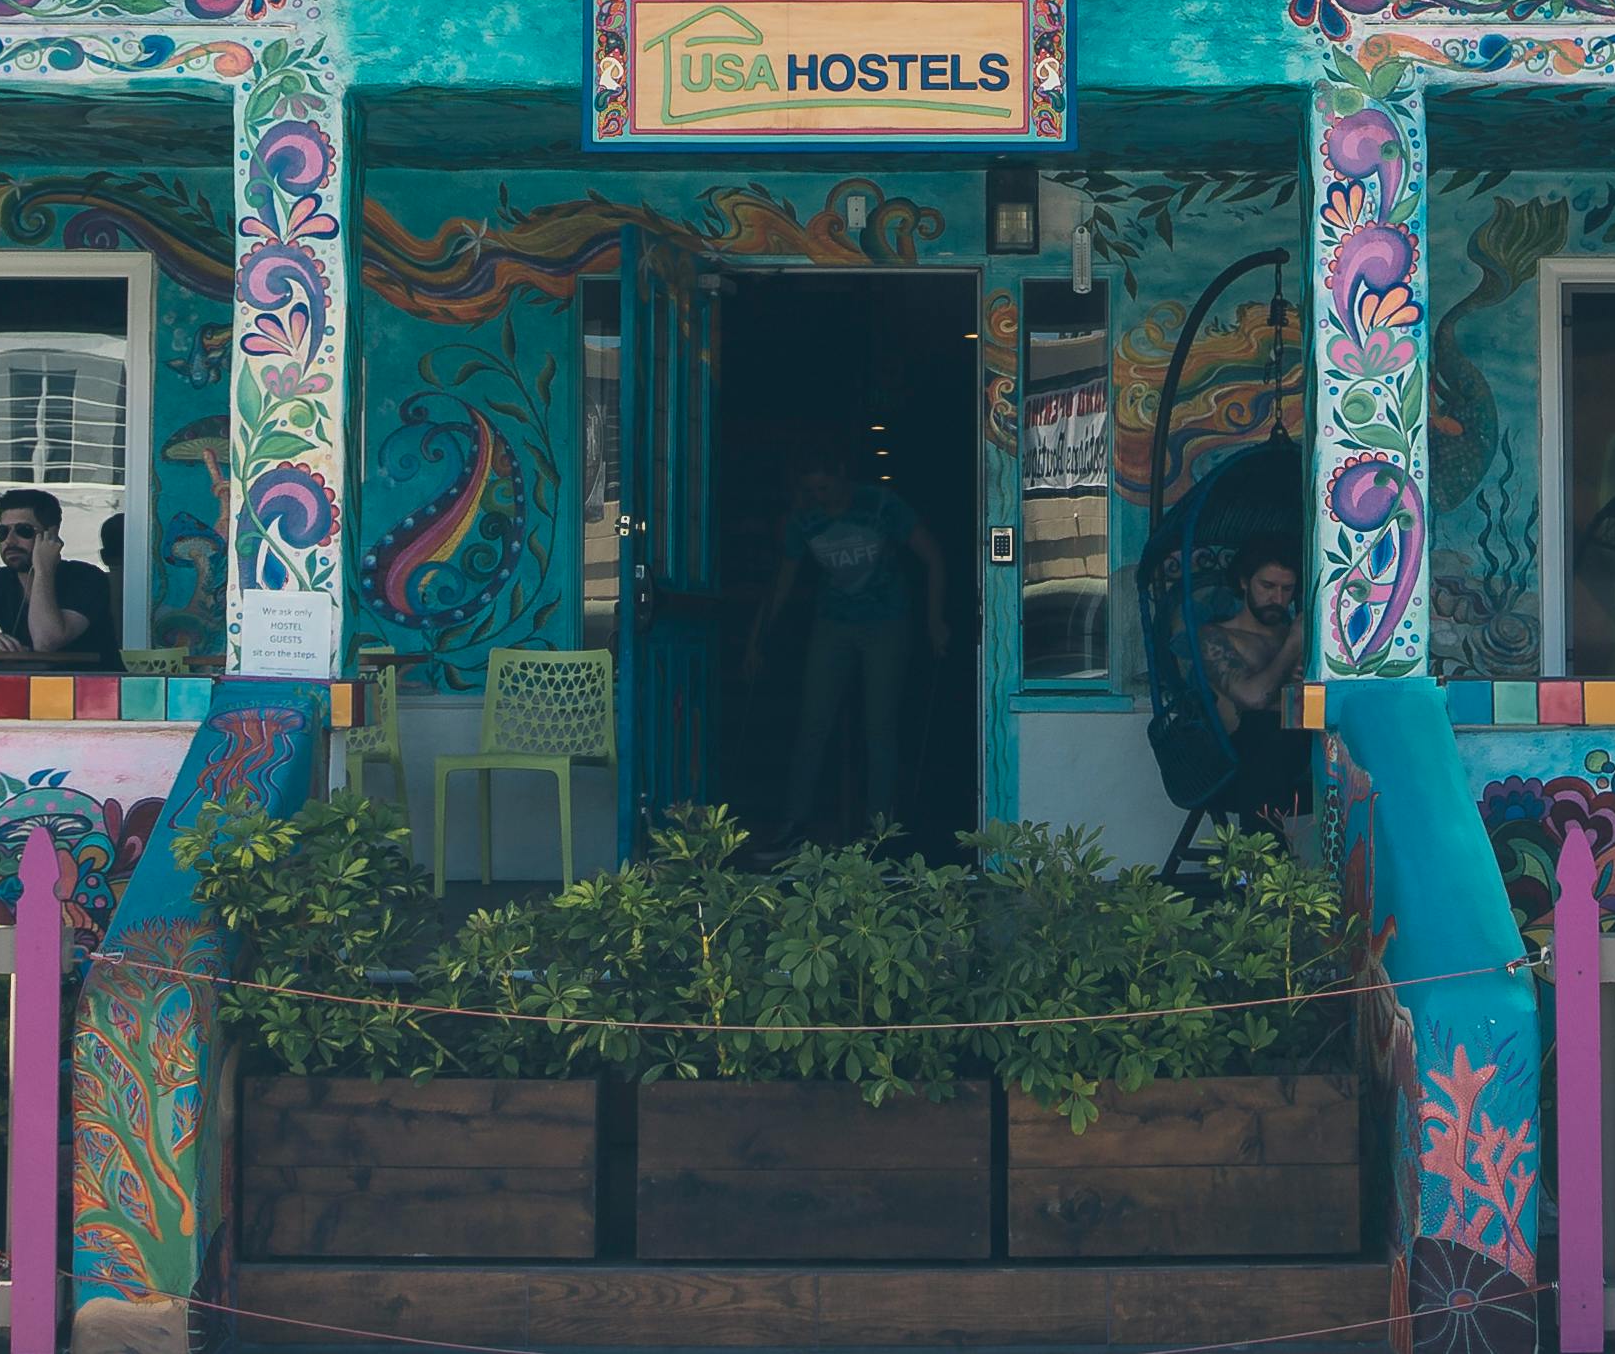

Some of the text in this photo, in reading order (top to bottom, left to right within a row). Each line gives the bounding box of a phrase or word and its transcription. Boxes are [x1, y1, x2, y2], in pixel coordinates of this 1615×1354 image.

[680, 52, 1010, 93] USA HOSTELS
[818, 544, 878, 567] STAFF
[262, 607, 313, 618] We ask only
[270, 622, 303, 631] HOSTEL
[269, 635, 303, 644] GUESTS
[277, 650, 291, 658] the
